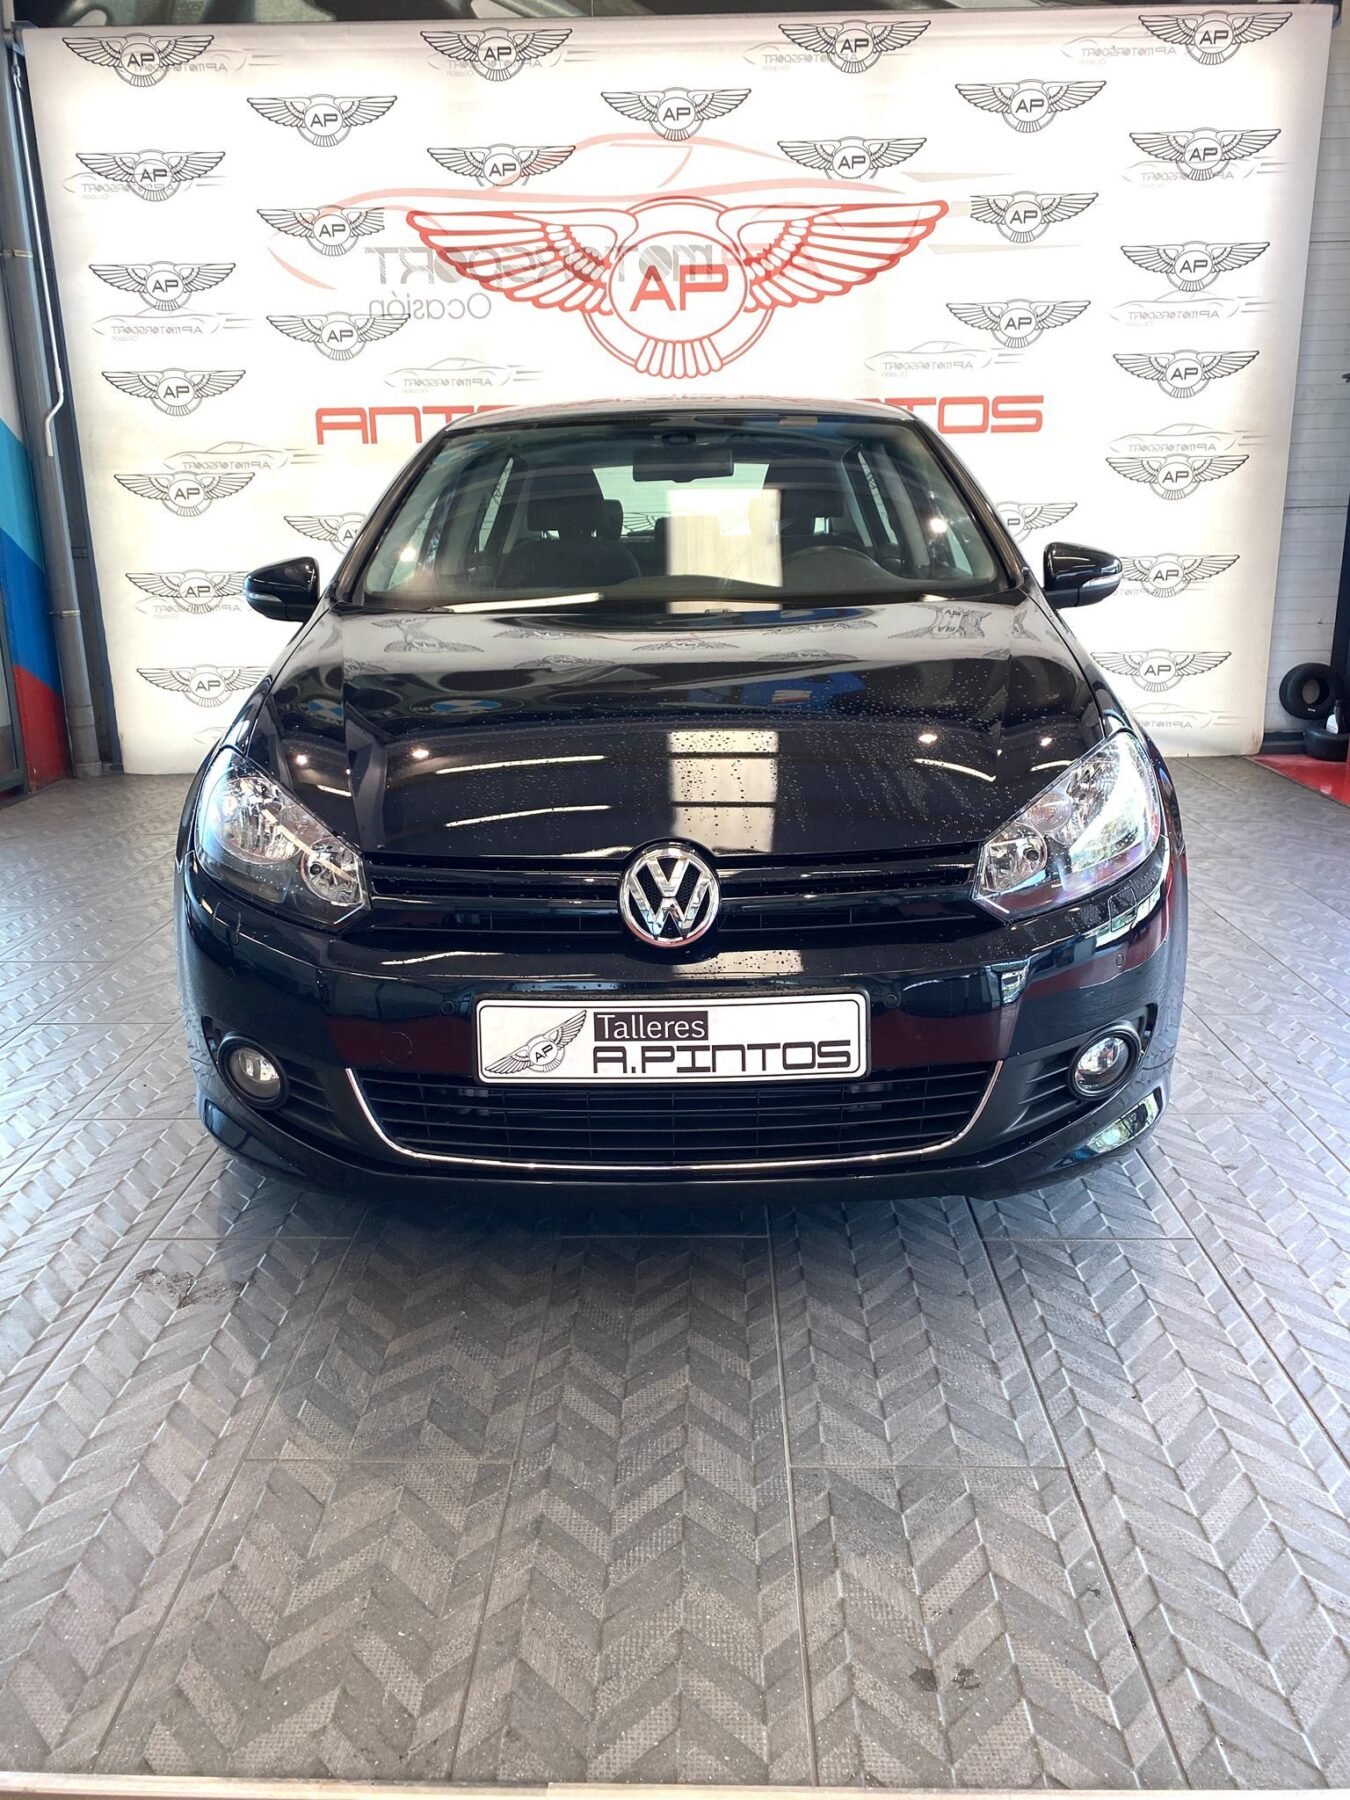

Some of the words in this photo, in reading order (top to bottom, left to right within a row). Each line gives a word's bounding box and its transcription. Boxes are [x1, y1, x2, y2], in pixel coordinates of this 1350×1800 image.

[1199, 29, 1228, 44] AP
[841, 38, 870, 52] AP
[127, 53, 154, 67] AP
[483, 47, 512, 60] AP
[1015, 98, 1044, 112] AP
[310, 113, 338, 127] AP
[663, 107, 690, 121] AP
[1190, 147, 1217, 160] AP
[838, 155, 865, 168] AP
[140, 169, 167, 182] AP
[489, 163, 516, 176] AP
[1010, 210, 1037, 223] AP
[319, 223, 345, 237] AP
[1179, 259, 1208, 272] AP
[152, 280, 178, 292] AP
[629, 264, 728, 311] AP
[1004, 317, 1031, 330] AP
[327, 330, 353, 342] AP
[1171, 367, 1198, 380] AP
[163, 386, 189, 398] AP
[1162, 471, 1188, 483] AP
[174, 488, 200, 500] AP
[1153, 570, 1179, 581] AP
[186, 586, 212, 597] AP
[1144, 664, 1172, 675] AP
[195, 681, 221, 692] AP
[596, 1014, 706, 1040] Talleres
[535, 1045, 553, 1062] AP
[593, 1039, 852, 1074] A.PINTOS
